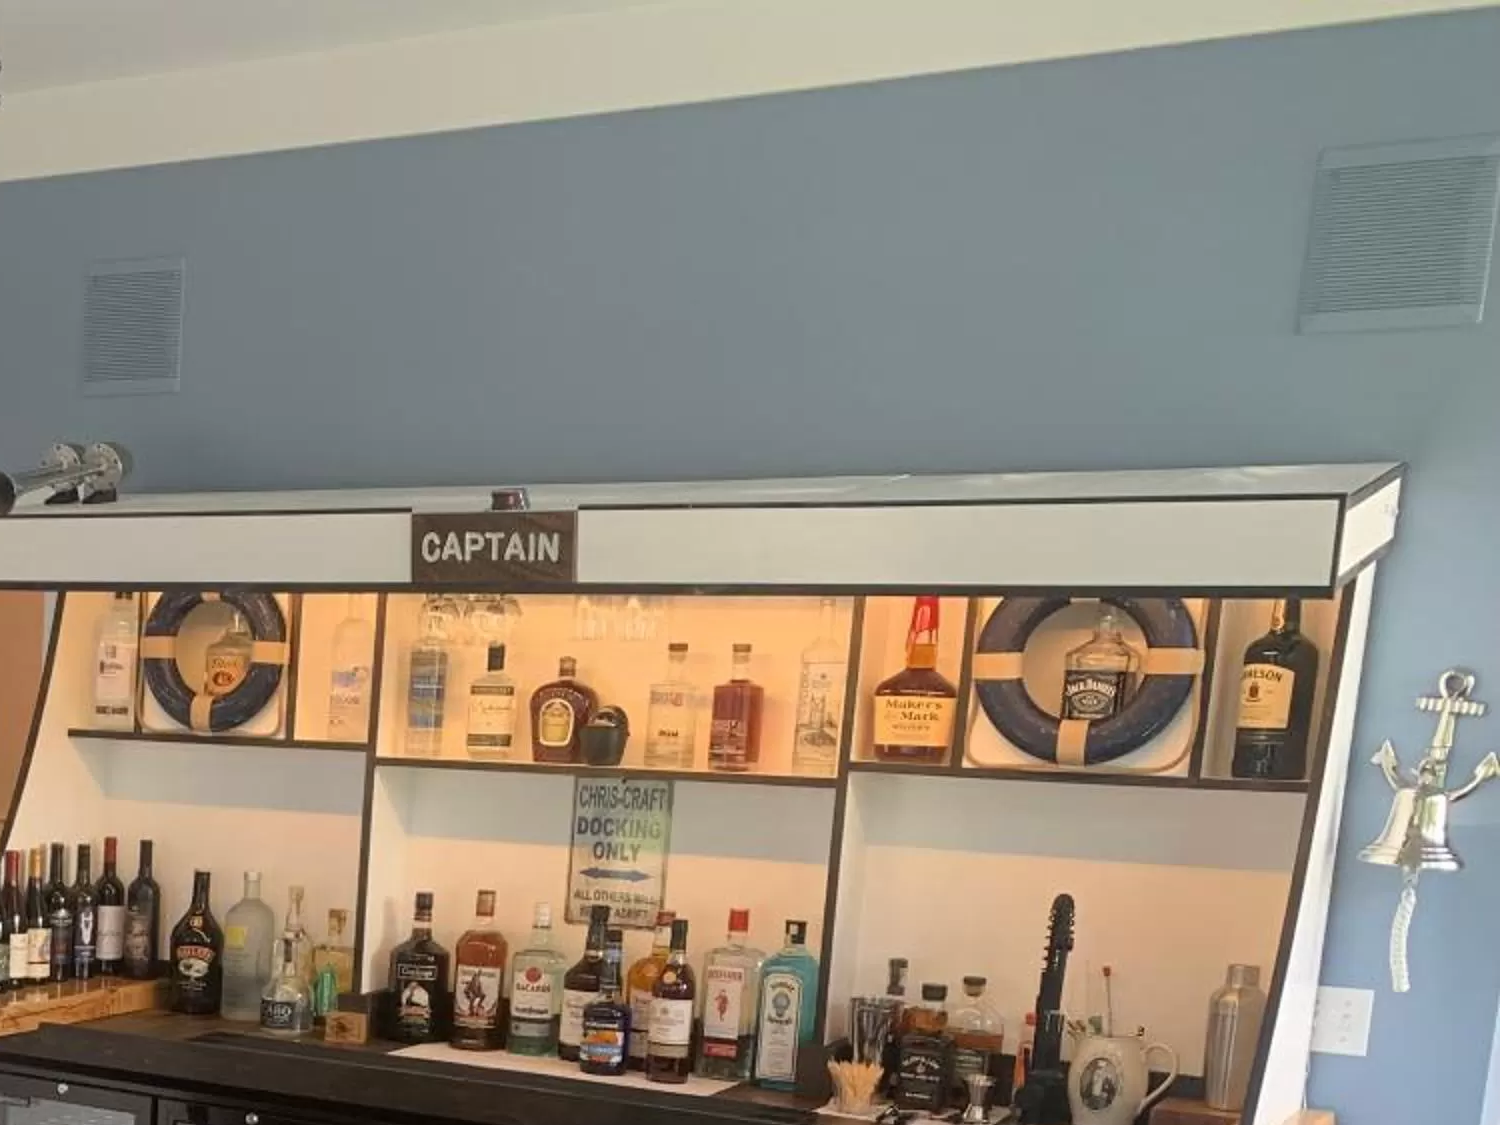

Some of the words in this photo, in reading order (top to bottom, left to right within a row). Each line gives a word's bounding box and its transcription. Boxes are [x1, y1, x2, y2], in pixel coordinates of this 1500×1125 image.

[422, 532, 560, 563] CAPTAIN
[579, 784, 666, 811] CHRIS-CRAFT
[577, 816, 661, 839] DOCKING
[593, 841, 640, 861] ONLY
[574, 888, 592, 900] ALL
